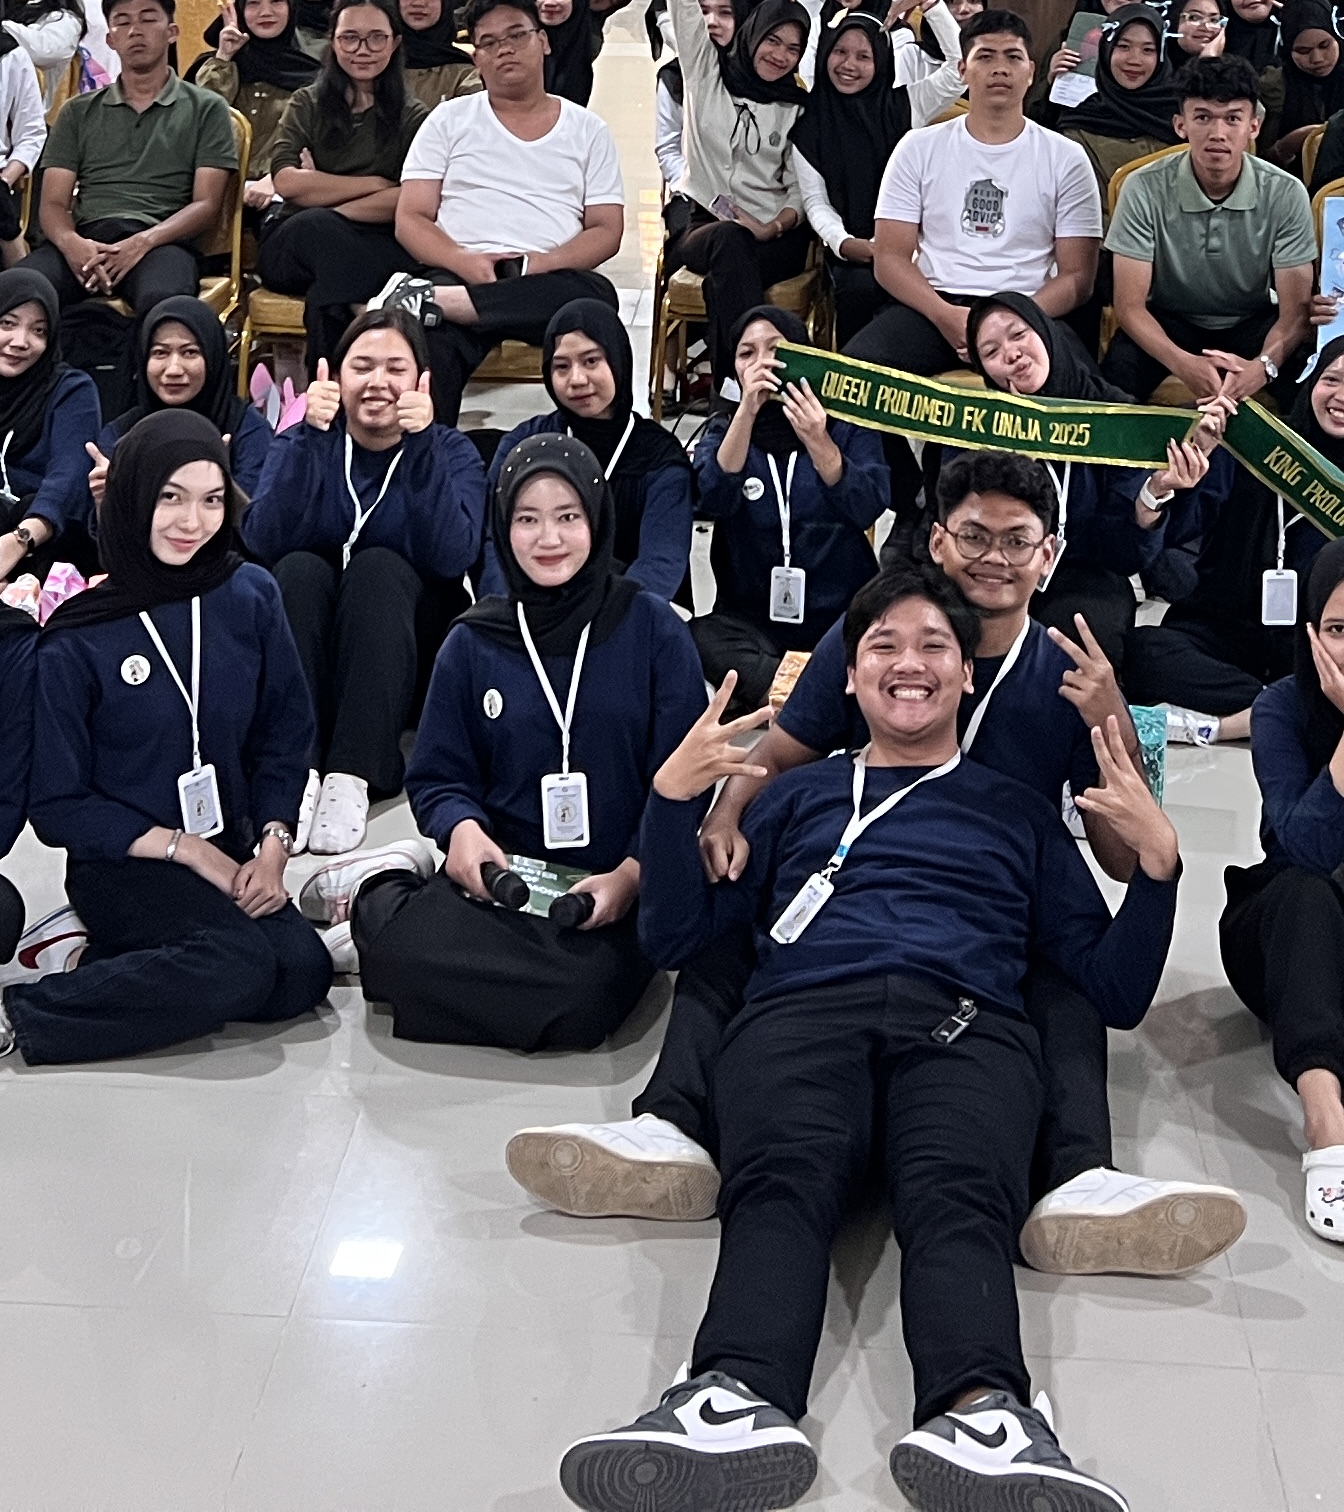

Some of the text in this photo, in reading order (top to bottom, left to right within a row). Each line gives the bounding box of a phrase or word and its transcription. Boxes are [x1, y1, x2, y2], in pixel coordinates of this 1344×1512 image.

[821, 371, 1092, 447] QUEEN PROLOMED FK UNAJA 2025
[1263, 445, 1309, 486] KING
